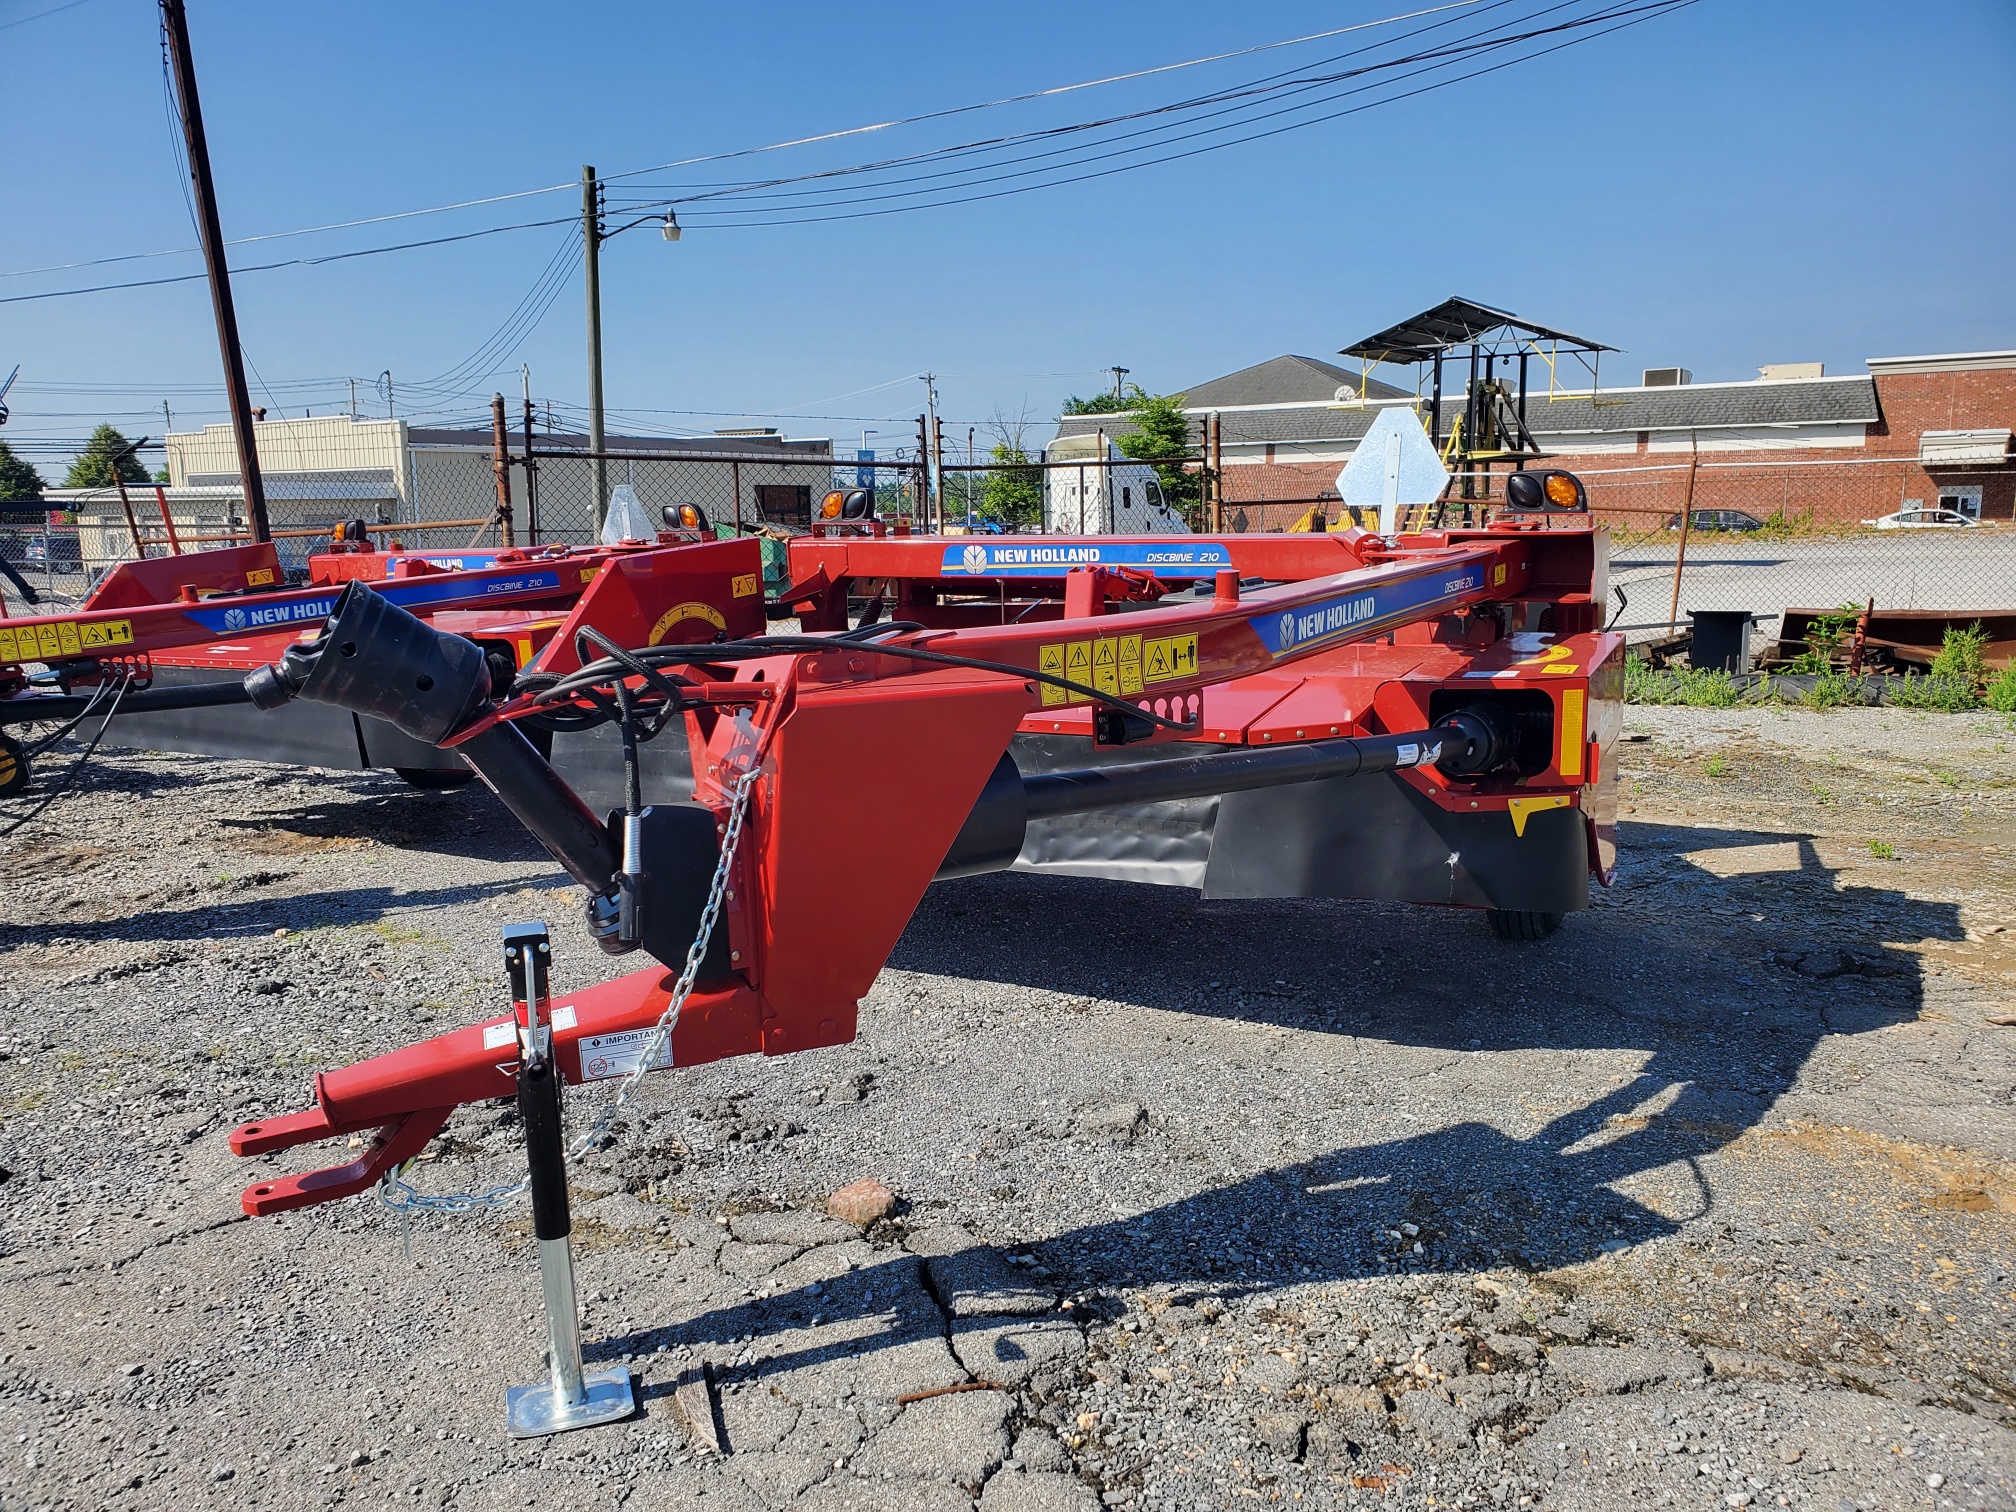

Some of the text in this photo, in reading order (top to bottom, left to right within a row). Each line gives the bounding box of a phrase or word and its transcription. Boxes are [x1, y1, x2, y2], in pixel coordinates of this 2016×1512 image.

[994, 548, 1100, 563] NEW HOLLAND
[1146, 552, 1220, 563] DISCBINE 210
[487, 578, 543, 593] DISCBINE 210
[250, 601, 332, 625] NEW HOLL
[1298, 596, 1375, 641] NEW HOLLAND
[605, 1030, 659, 1045] IMPORTAN
